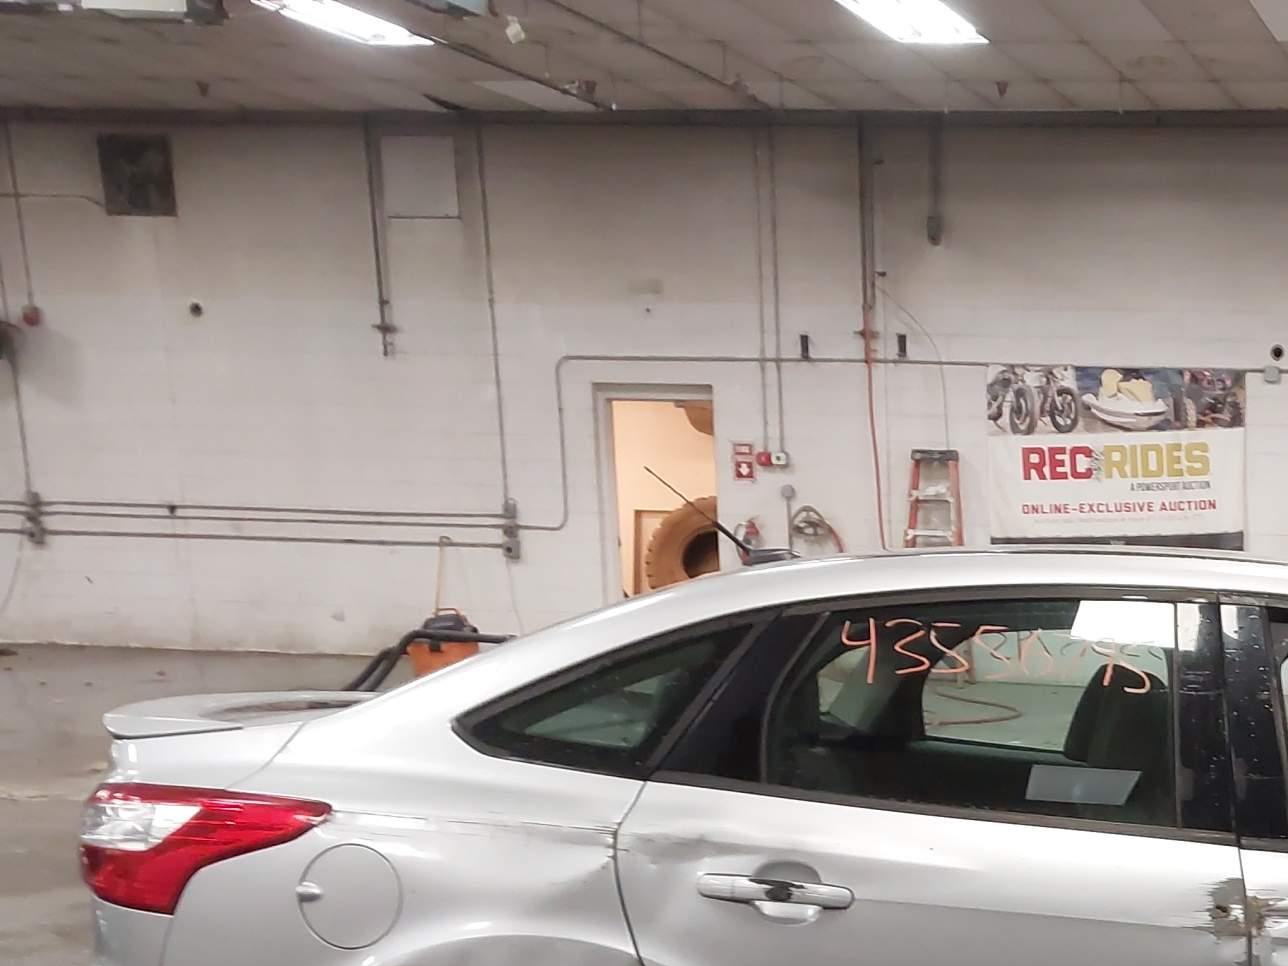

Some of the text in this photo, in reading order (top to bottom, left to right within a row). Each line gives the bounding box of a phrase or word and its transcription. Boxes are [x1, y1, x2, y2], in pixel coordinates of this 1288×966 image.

[1021, 442, 1211, 481] REC RIDES
[1021, 499, 1217, 515] ONLINE-EXCLUSIVE AUCTION
